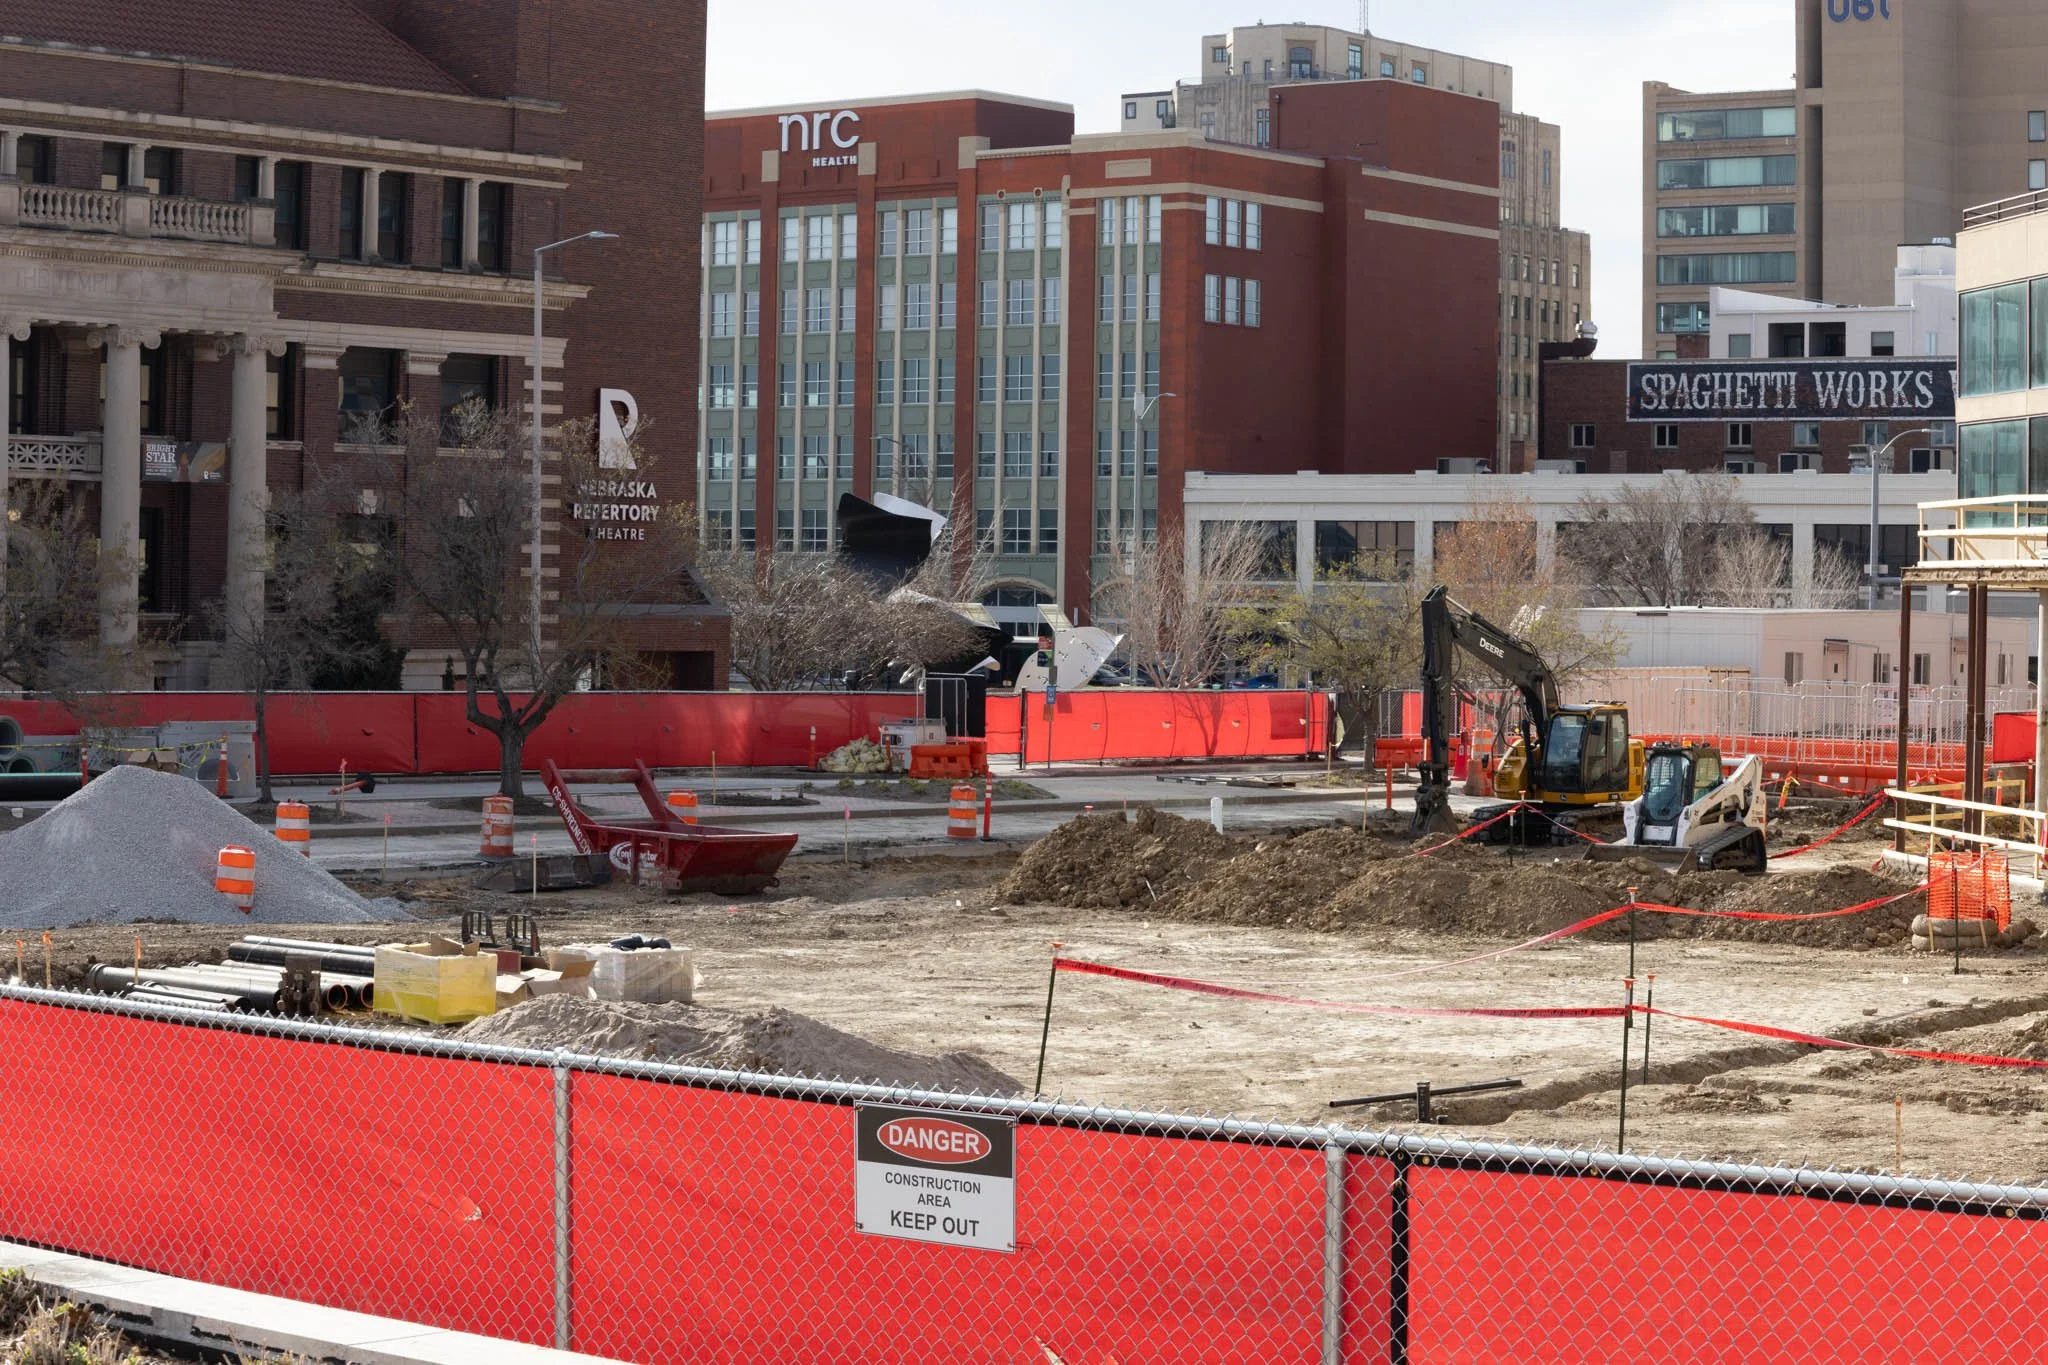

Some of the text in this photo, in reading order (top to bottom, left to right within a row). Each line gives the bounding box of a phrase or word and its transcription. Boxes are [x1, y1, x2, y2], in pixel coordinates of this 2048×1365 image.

[778, 110, 860, 152] nrc
[812, 155, 857, 167] HEALTH
[1640, 371, 1798, 410] SPAGHETTI
[1812, 370, 1934, 409] WORKS
[145, 452, 177, 463] STAR
[146, 443, 177, 452] BRIGHT
[1479, 637, 1505, 658] DEERE
[888, 1124, 981, 1155] DANGER
[885, 1172, 981, 1194] CONSTRUCTION
[917, 1193, 952, 1208] AREA
[890, 1210, 980, 1237] KEEP OUT
